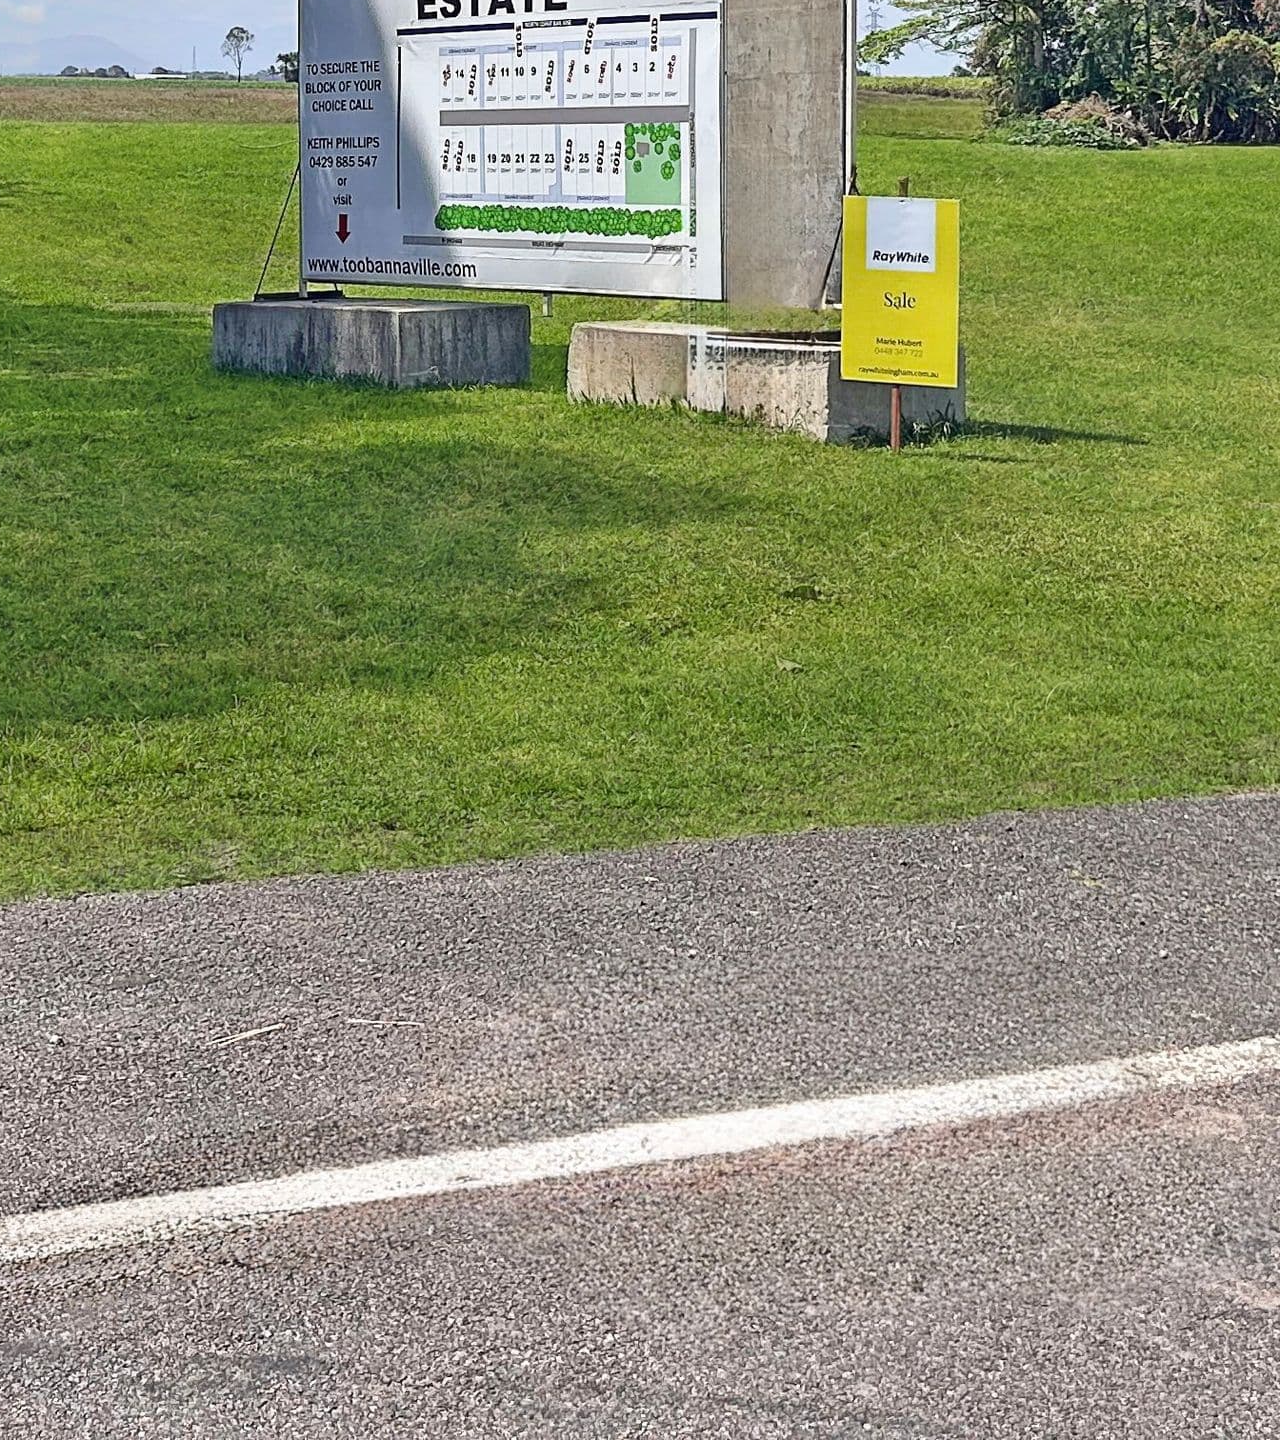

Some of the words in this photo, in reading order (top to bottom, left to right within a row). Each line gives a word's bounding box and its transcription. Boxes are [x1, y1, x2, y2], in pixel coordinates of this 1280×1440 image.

[515, 24, 523, 58] SOLD
[584, 21, 595, 55] SOLD
[650, 17, 658, 52] SOLD
[306, 63, 318, 75] TO
[320, 62, 358, 75] SECURE
[360, 60, 380, 73] THE
[455, 68, 464, 78] 14
[500, 67, 509, 77] 11
[515, 66, 524, 77] 10
[530, 66, 537, 76] 9
[616, 63, 622, 73] 4
[632, 62, 638, 72] 3
[649, 61, 655, 72] 2
[468, 64, 477, 96] SOLD
[545, 60, 555, 93] SOLD
[305, 81, 336, 94] BLOCK
[338, 80, 352, 93] OF
[354, 79, 382, 92] YOUR
[312, 99, 347, 112] CHOICE
[349, 98, 374, 111] CALL
[307, 137, 333, 150] KEITH
[336, 136, 380, 149] PHILLIPS
[442, 138, 451, 171] SOLD
[455, 140, 464, 172] SOLD
[467, 153, 476, 163] 18
[487, 153, 497, 163] 19
[500, 153, 511, 163] 20
[515, 153, 525, 163] 21
[529, 153, 540, 163] 22
[544, 153, 555, 163] 23
[564, 138, 573, 172] SOLD
[578, 153, 590, 163] 25
[596, 139, 605, 173] SOLD
[612, 140, 622, 175] SOLD
[309, 156, 333, 169] 0429
[357, 155, 378, 167] 547
[337, 176, 347, 187] or
[333, 193, 352, 206] visit
[308, 256, 477, 278] www.toobannaville.com
[884, 291, 916, 310] Sale
